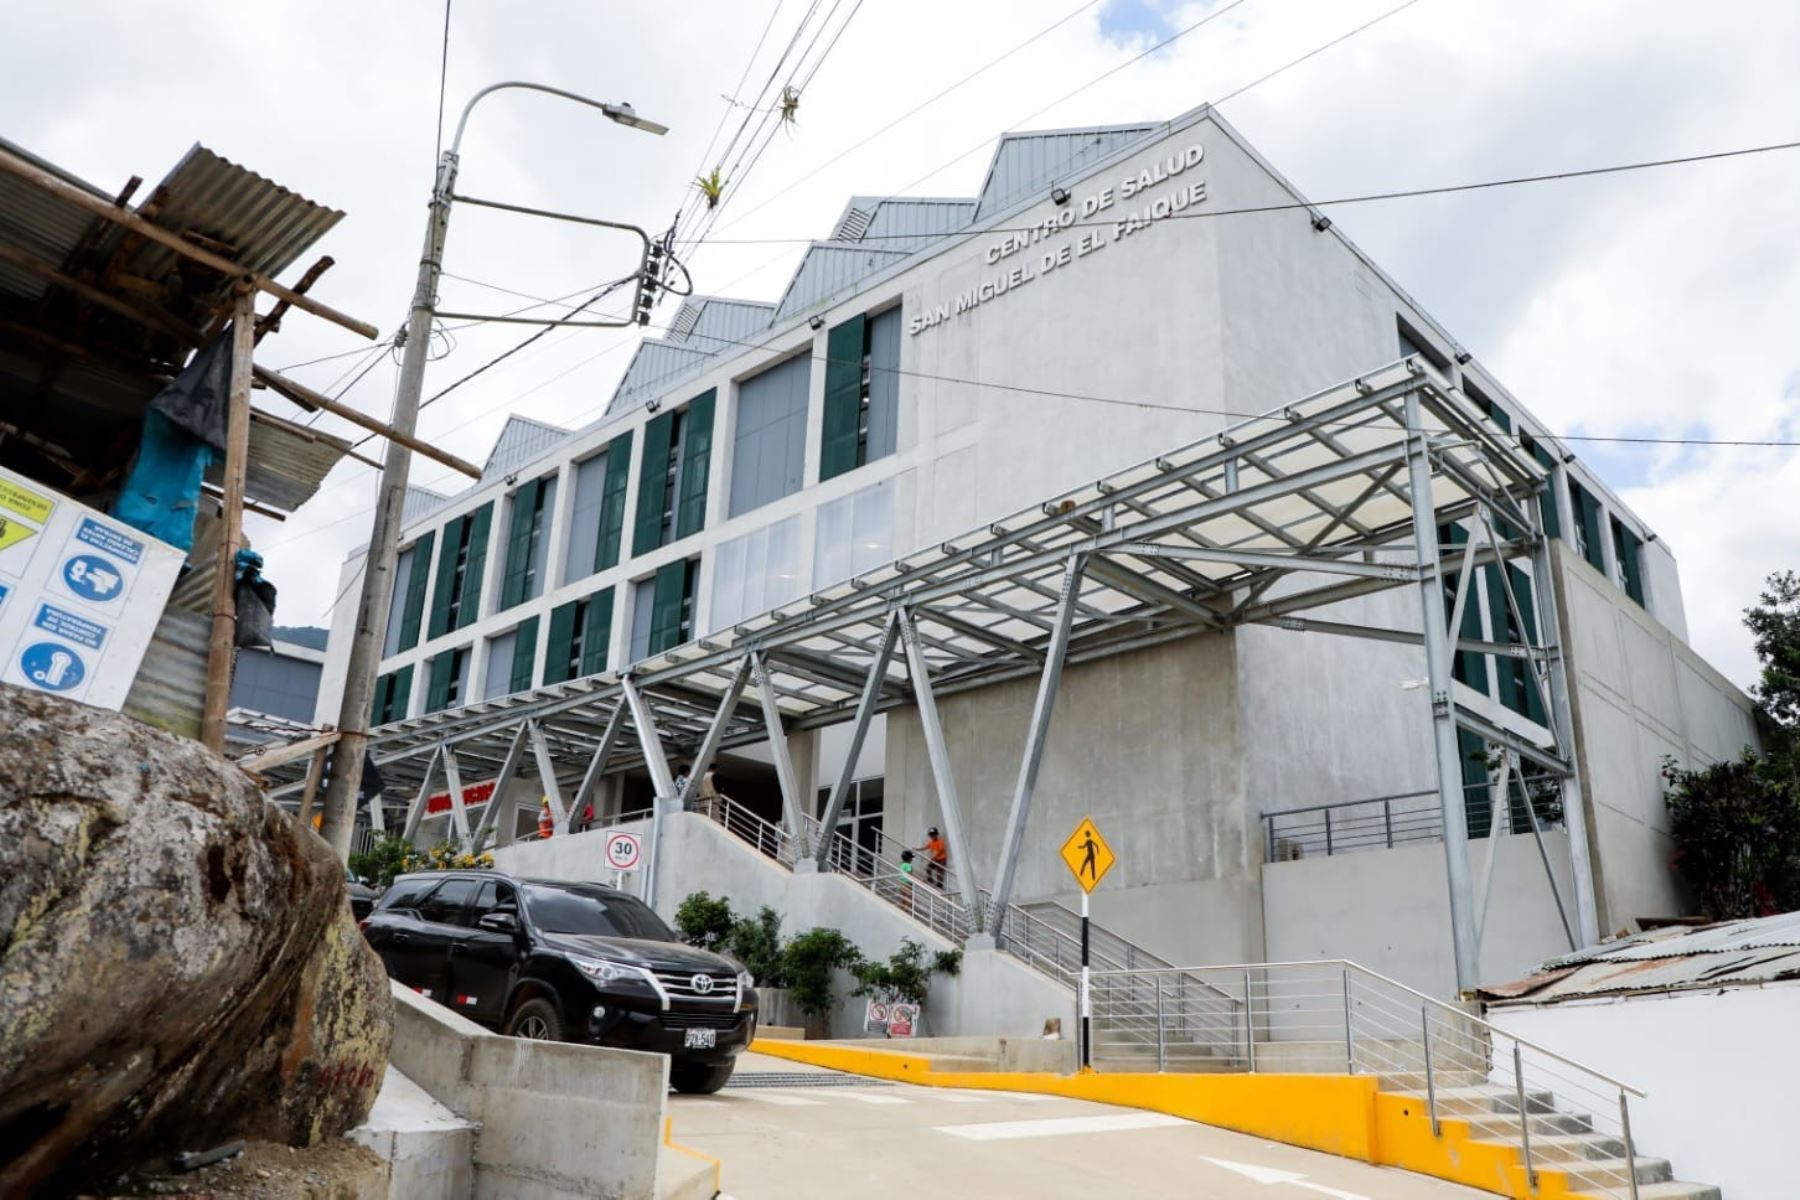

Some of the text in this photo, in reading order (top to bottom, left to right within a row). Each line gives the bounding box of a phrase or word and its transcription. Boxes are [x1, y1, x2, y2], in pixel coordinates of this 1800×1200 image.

[909, 181, 1208, 336] SAN MIGUEL DE EL FAIQUE
[986, 144, 1204, 265] CENTRO DE SALUD
[615, 842, 632, 855] 30
